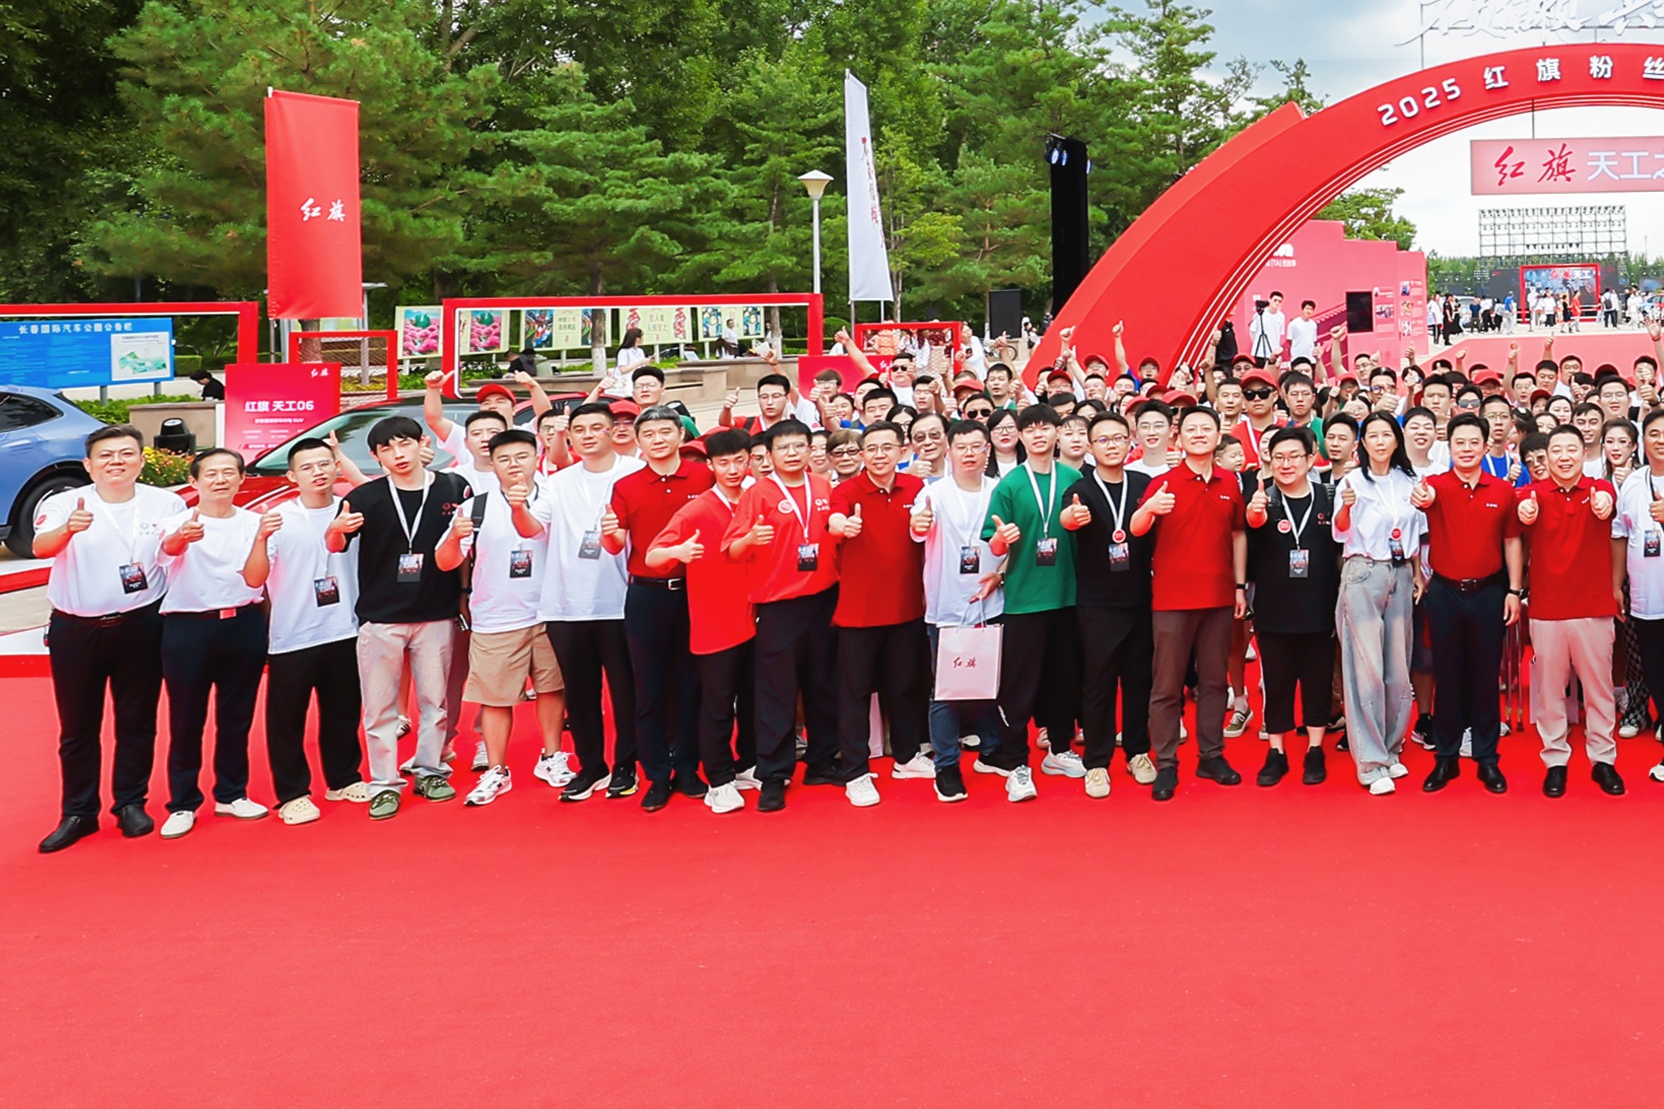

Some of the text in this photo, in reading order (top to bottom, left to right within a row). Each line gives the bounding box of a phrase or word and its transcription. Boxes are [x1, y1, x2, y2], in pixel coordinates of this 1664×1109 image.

[1493, 143, 1576, 186] 红旗
[300, 197, 346, 222] 红旗
[18, 322, 133, 334] 长春国际汽车公园公告栏
[244, 400, 314, 412] 红旗 天工06
[953, 656, 977, 668] 红旗
